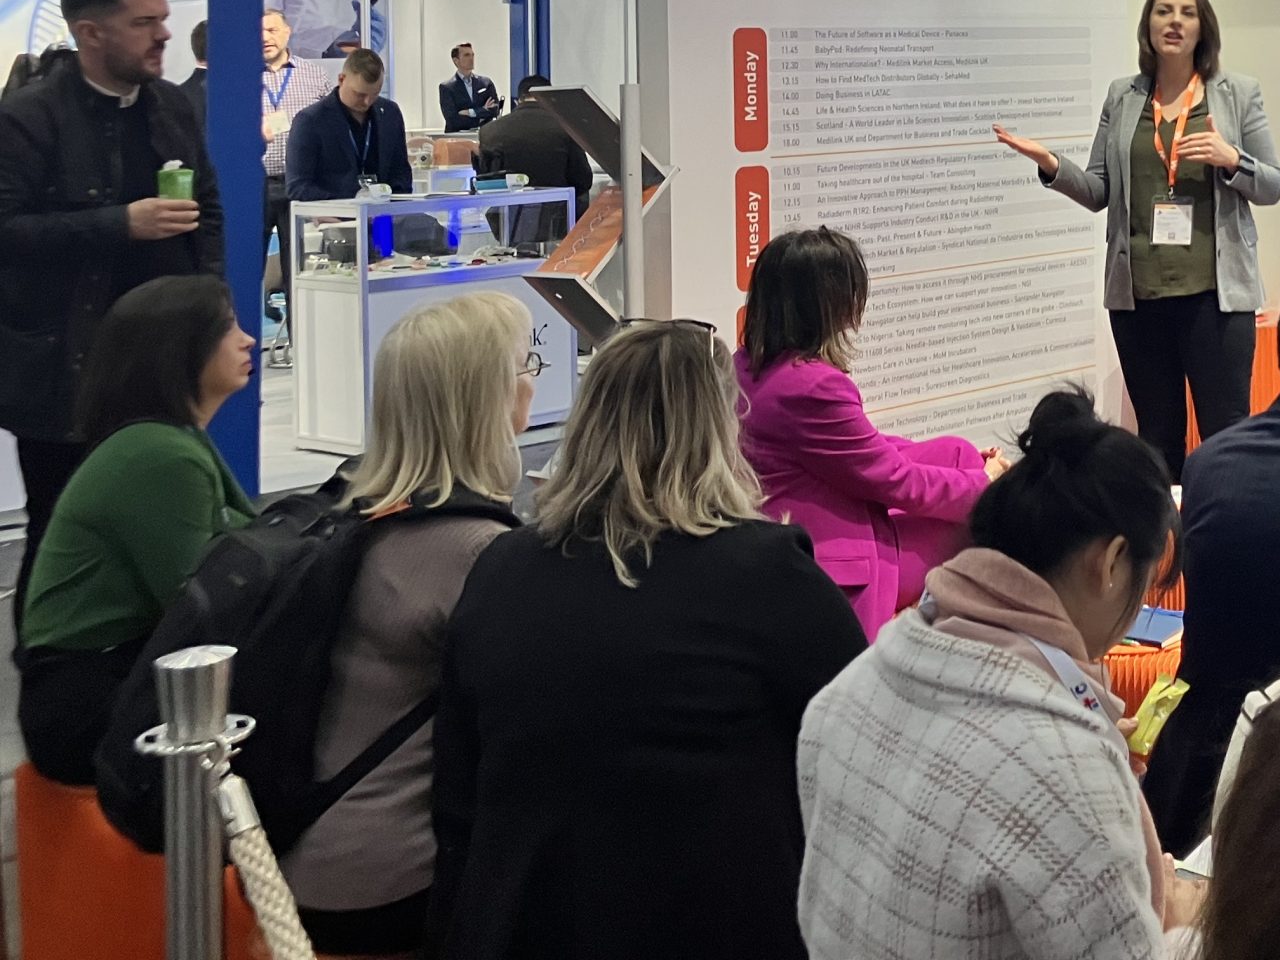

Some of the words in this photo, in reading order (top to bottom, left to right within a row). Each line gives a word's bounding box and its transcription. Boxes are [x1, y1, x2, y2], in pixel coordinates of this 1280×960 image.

[815, 61, 828, 71] Why
[744, 51, 759, 121] Monday
[815, 92, 834, 101] Doing
[835, 91, 863, 99] Business
[816, 106, 827, 115] Life
[835, 105, 856, 114] Health
[943, 101, 958, 109] What
[816, 121, 843, 130] Scotland
[855, 119, 872, 128] World
[874, 118, 894, 127] Leader
[816, 164, 837, 174] Future
[817, 179, 838, 189] Taking
[839, 176, 871, 187] healthcare
[746, 191, 762, 268] Tuesday
